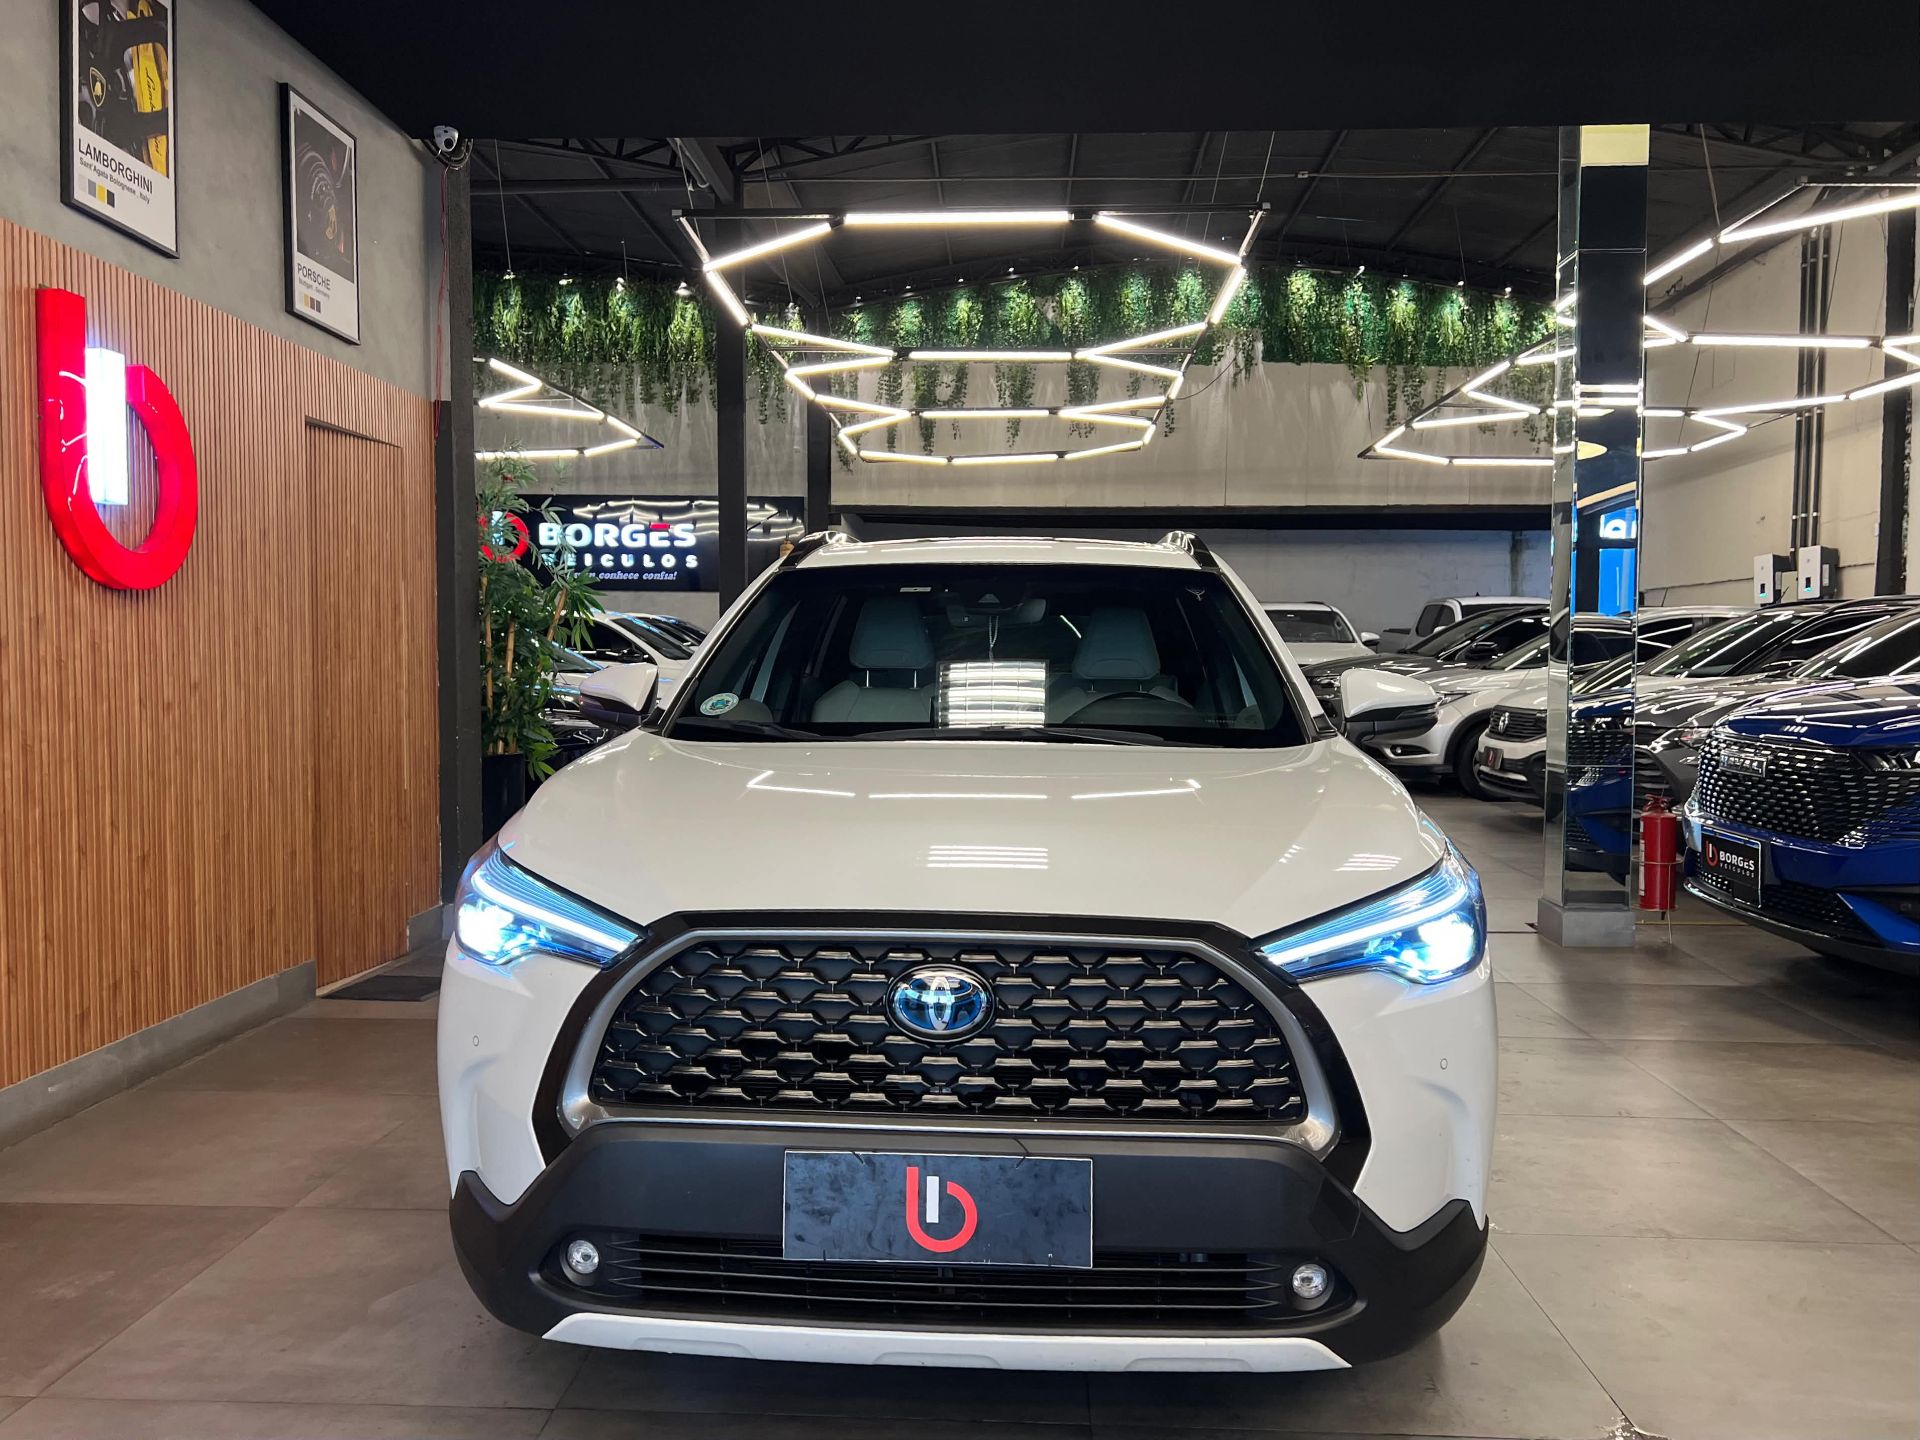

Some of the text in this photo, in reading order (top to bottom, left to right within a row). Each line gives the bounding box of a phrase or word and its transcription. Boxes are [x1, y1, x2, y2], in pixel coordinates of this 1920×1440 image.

[78, 137, 153, 195] LAMBORGHINI
[297, 262, 332, 291] PORSCHE
[538, 521, 697, 547] BORGES
[598, 570, 640, 581] conhece
[1719, 850, 1755, 871] BORGES
